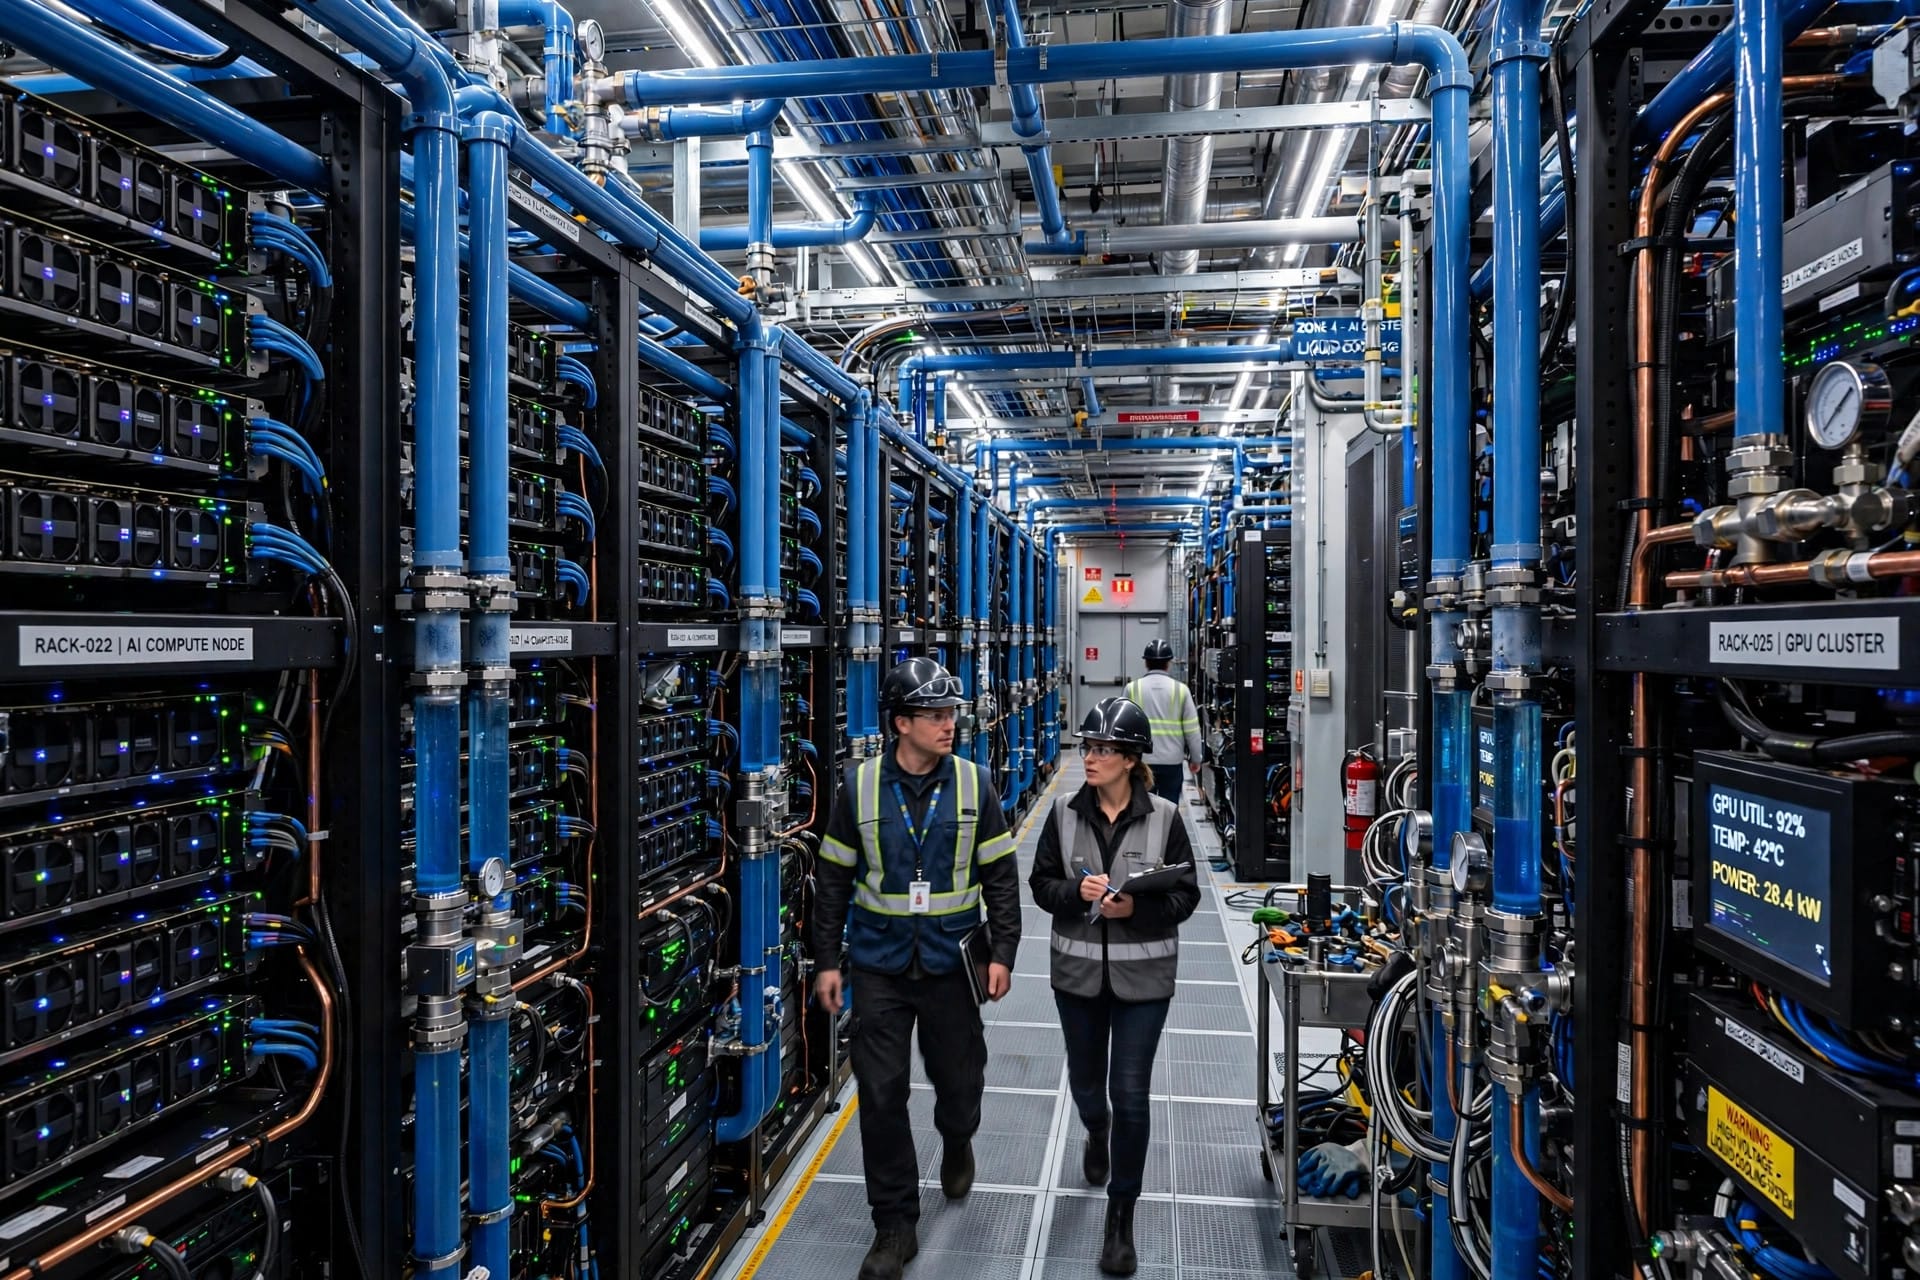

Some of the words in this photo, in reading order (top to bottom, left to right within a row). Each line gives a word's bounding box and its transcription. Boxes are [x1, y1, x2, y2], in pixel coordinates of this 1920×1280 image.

[1296, 321, 1327, 333] ZONE
[1348, 321, 1359, 331] AI
[35, 637, 113, 654] RACK-022
[127, 637, 141, 653] AI
[146, 637, 208, 652] COMPUTE
[212, 637, 245, 651] NODE
[1719, 633, 1773, 652] RACK-025
[1785, 633, 1812, 653] GPU
[1817, 633, 1885, 654] CLUSTER
[1712, 793, 1737, 819] GPU
[1740, 799, 1773, 830] UTIL:
[1776, 810, 1806, 839] 92%
[1713, 824, 1750, 855] TEMP:
[1713, 860, 1760, 898] POWER:
[1763, 881, 1794, 911] 28.4
[1798, 893, 1822, 923] kW
[1726, 1103, 1773, 1154] WARNING:
